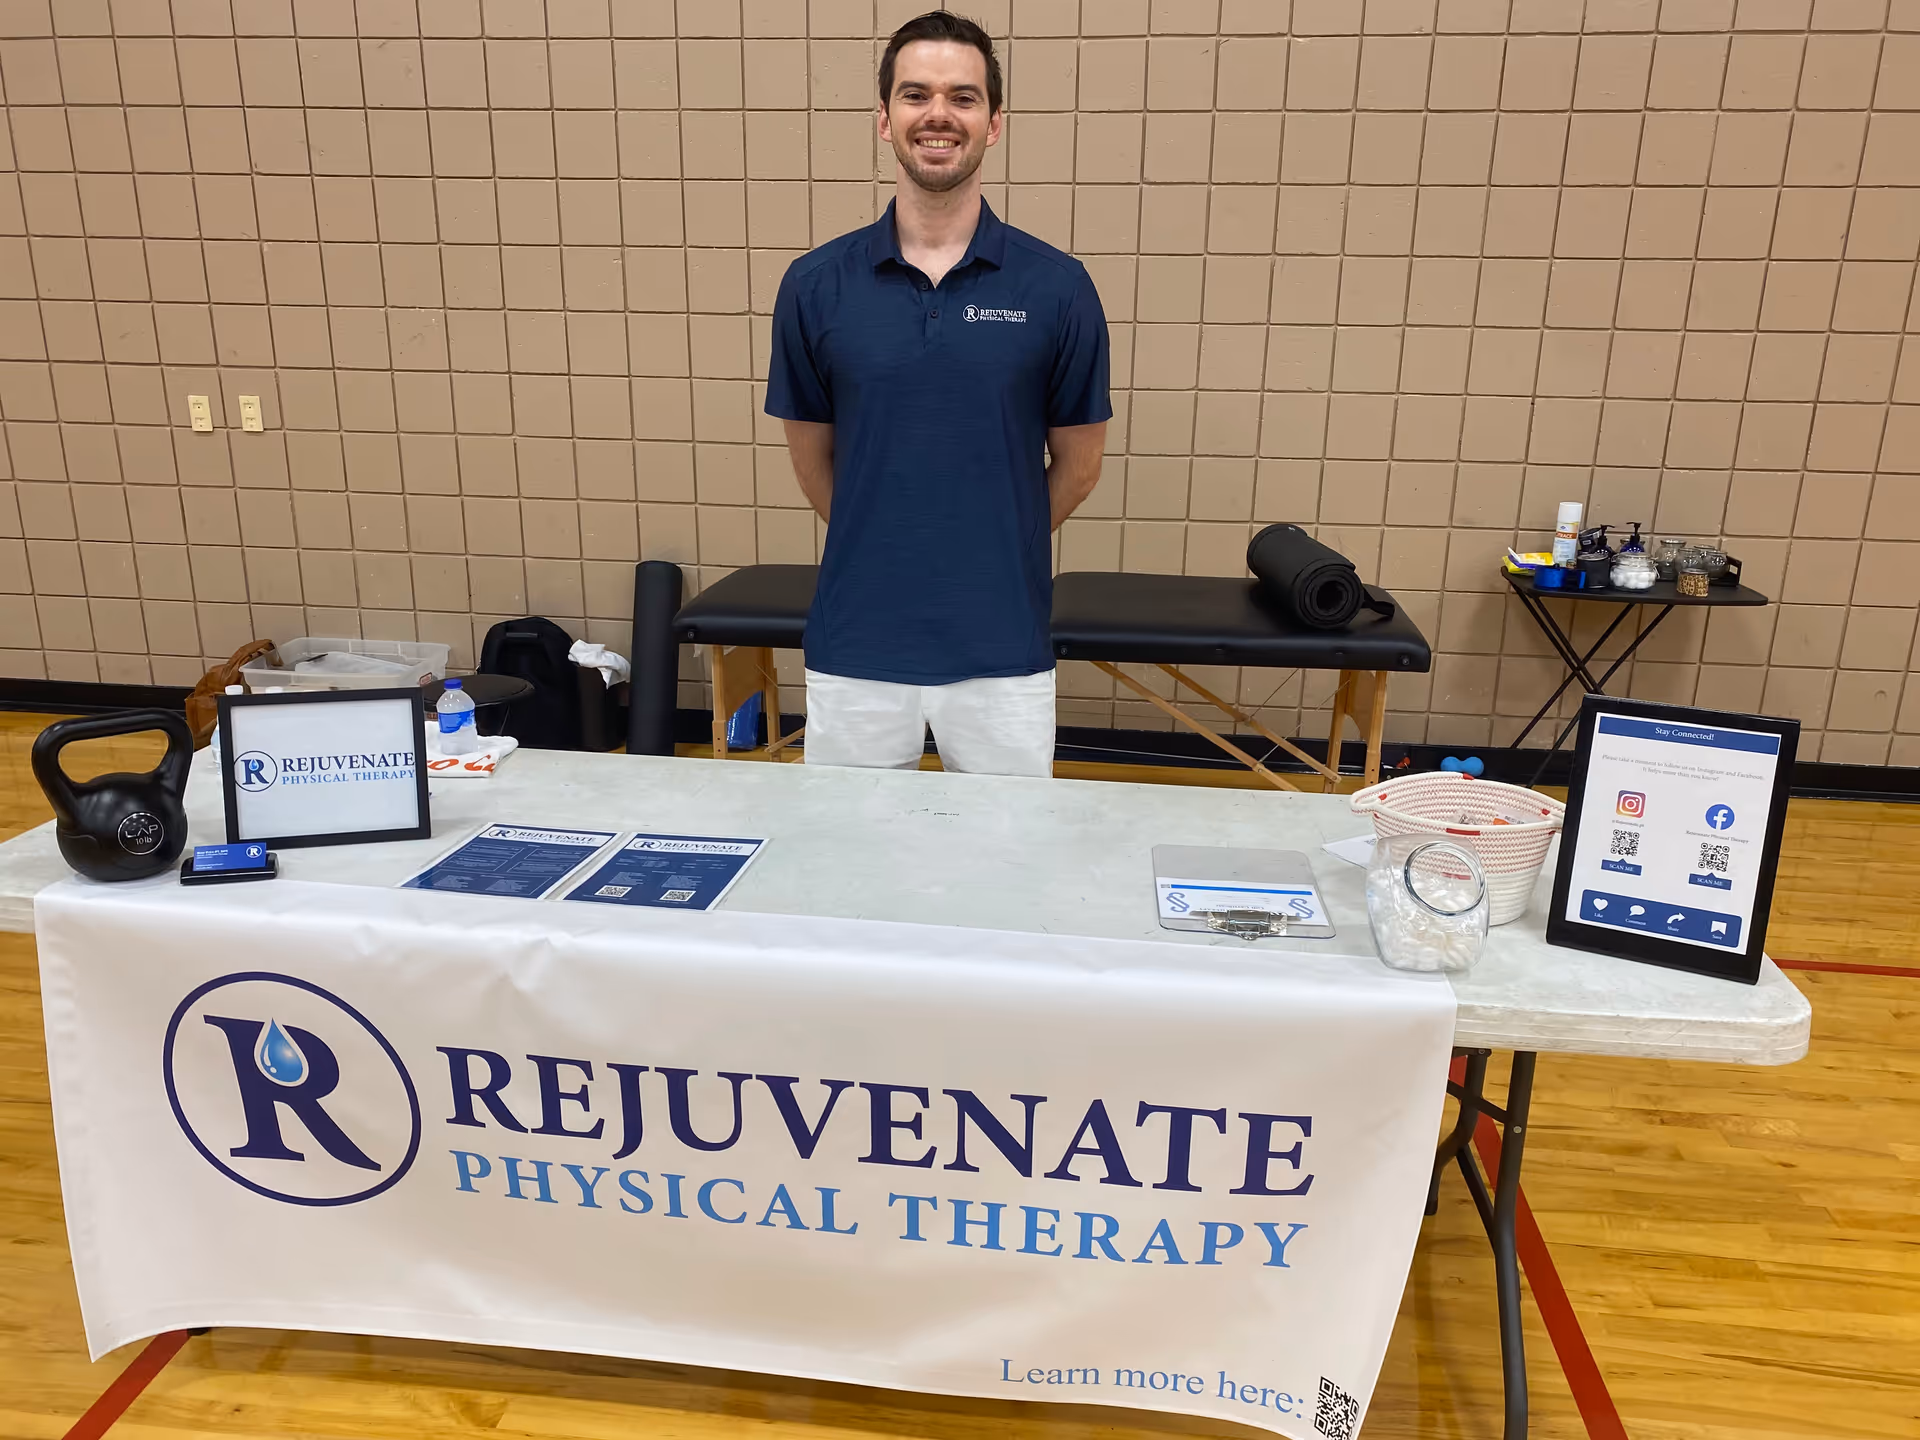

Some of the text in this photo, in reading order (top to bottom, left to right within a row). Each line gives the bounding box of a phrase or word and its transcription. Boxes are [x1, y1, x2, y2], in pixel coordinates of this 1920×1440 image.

[980, 309, 1026, 318] REJUVENATE
[1655, 727, 1715, 741] Stay Connected!
[281, 752, 415, 774] REJUVENATE
[282, 769, 415, 785] PHYSICAL THERAPY
[518, 831, 597, 842] REJUVENATE
[663, 842, 743, 851] REJUVENATE
[1609, 863, 1624, 871] SCAN
[1697, 877, 1713, 885] SCAN
[436, 1046, 1315, 1196] REJUVENATE
[448, 1149, 1308, 1269] PHYSICAL THERAPY
[1000, 1358, 1304, 1419] Learn more here:
